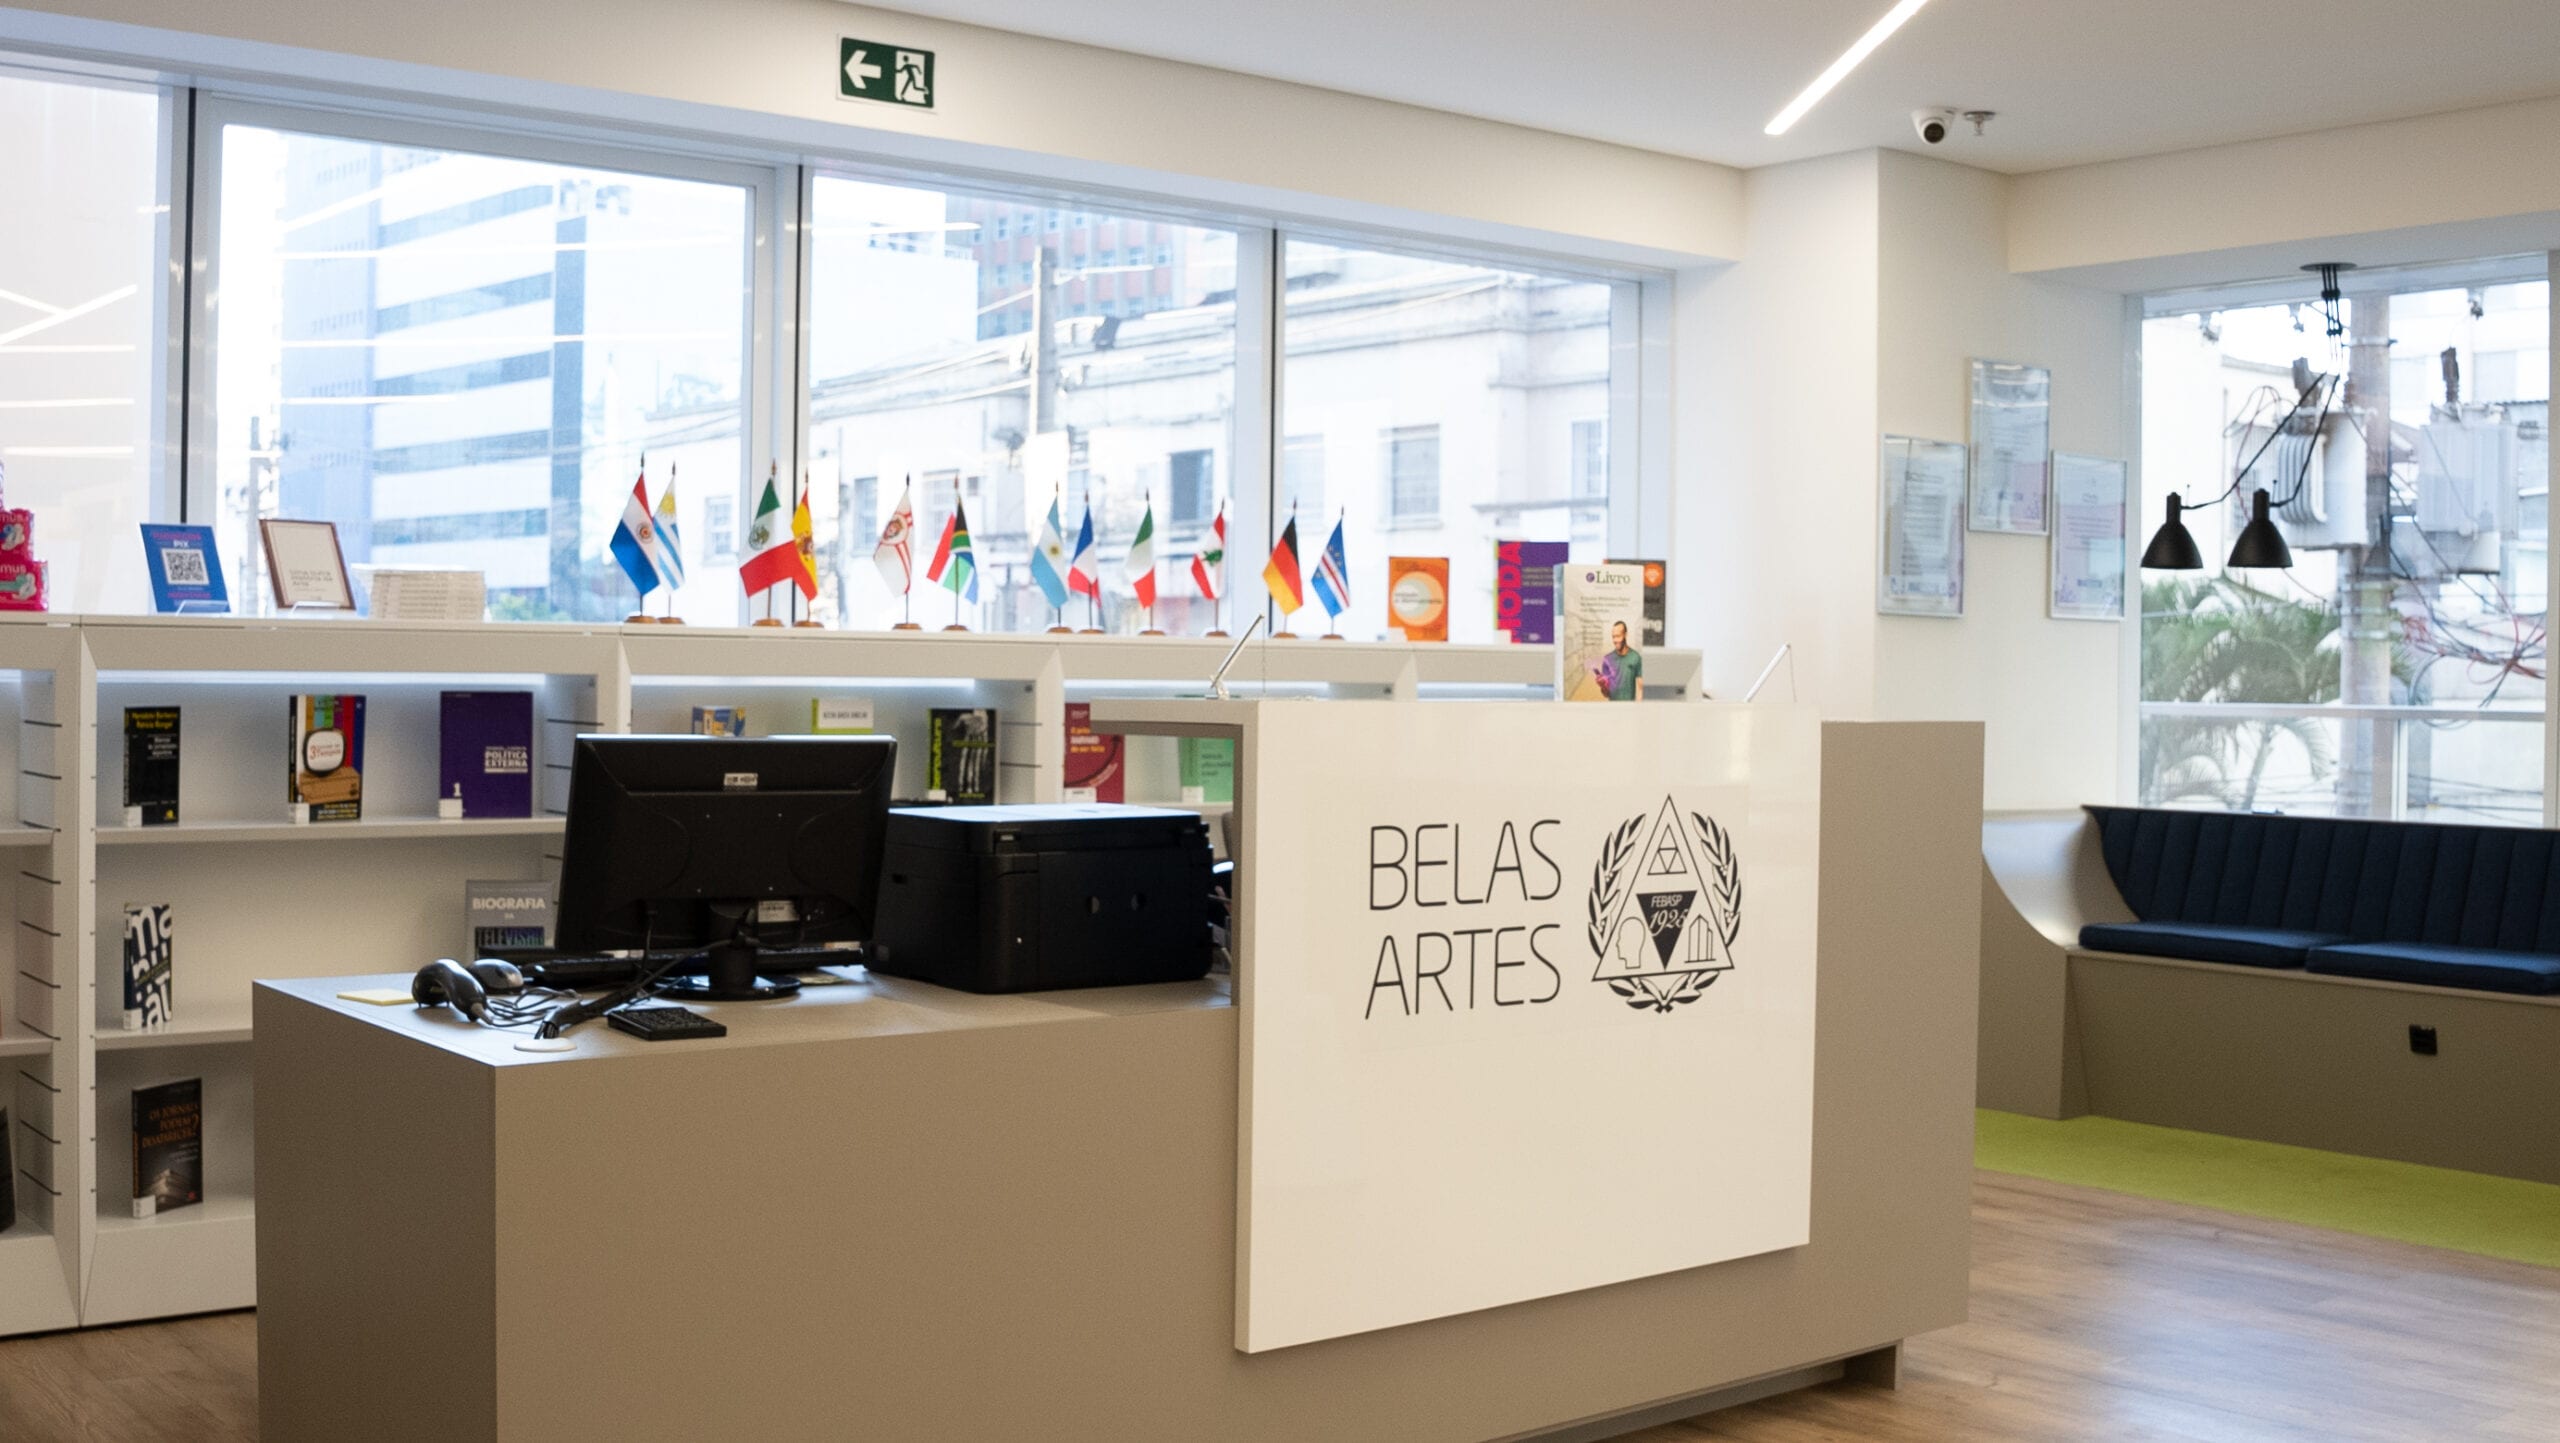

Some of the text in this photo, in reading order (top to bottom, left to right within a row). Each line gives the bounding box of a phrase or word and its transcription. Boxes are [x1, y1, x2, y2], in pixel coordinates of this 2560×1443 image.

[484, 749, 528, 759] POLÍTICA
[484, 760, 528, 768] EXTERNA
[1369, 819, 1562, 911] BELAS
[472, 897, 546, 910] BIOGRAFIA
[1651, 894, 1683, 908] FEBASP
[1365, 923, 1562, 1020] ARTES
